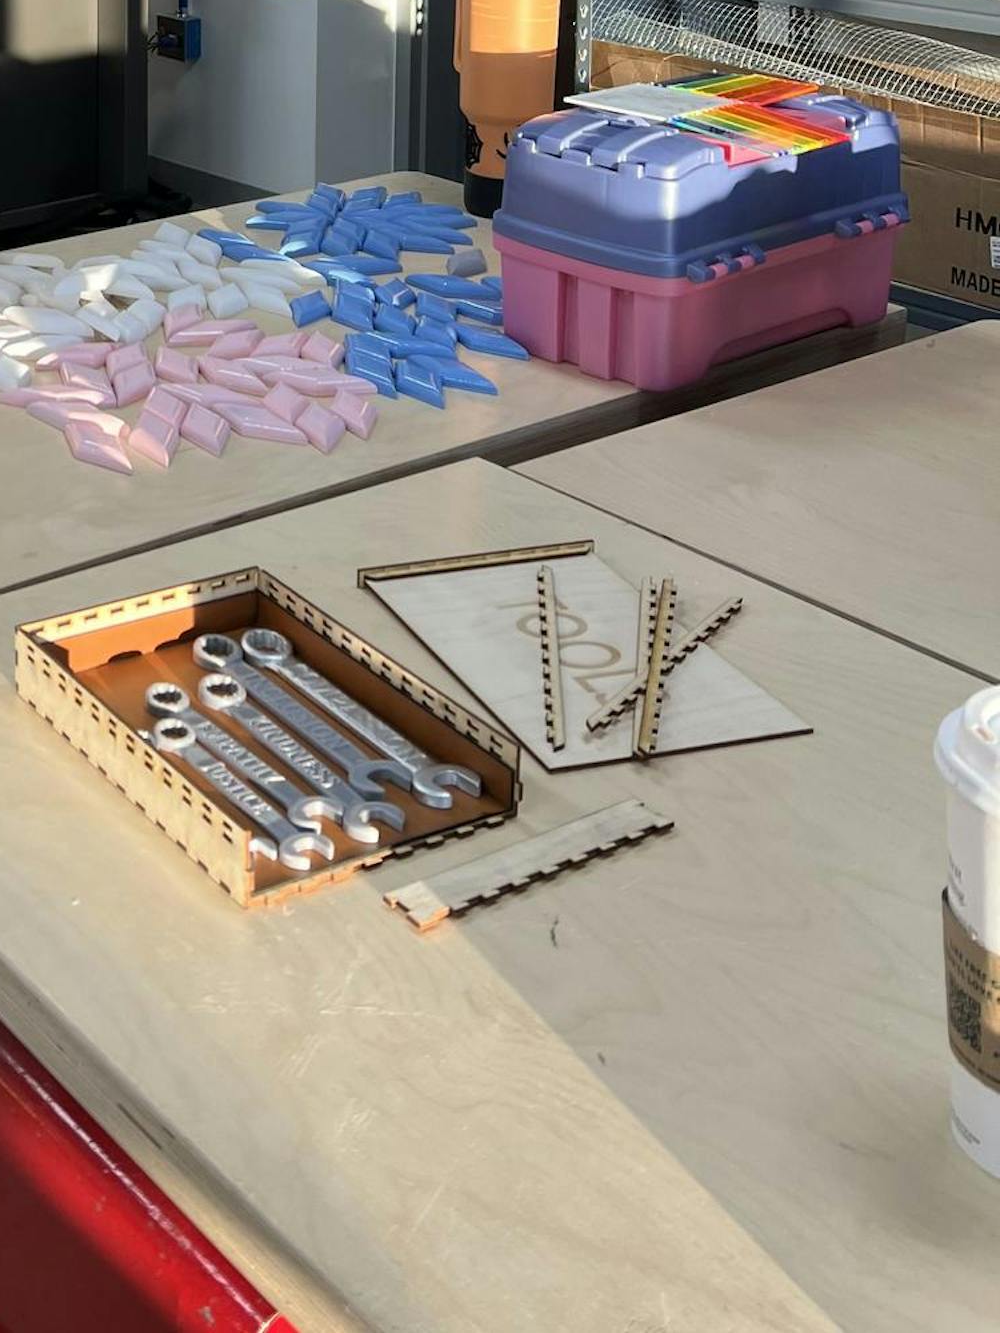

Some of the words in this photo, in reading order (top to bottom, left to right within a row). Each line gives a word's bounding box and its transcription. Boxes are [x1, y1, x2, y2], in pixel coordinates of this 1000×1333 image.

[955, 207, 1000, 236] HM
[250, 715, 337, 789] KINDNESS
[200, 762, 273, 816] JUSTICE
